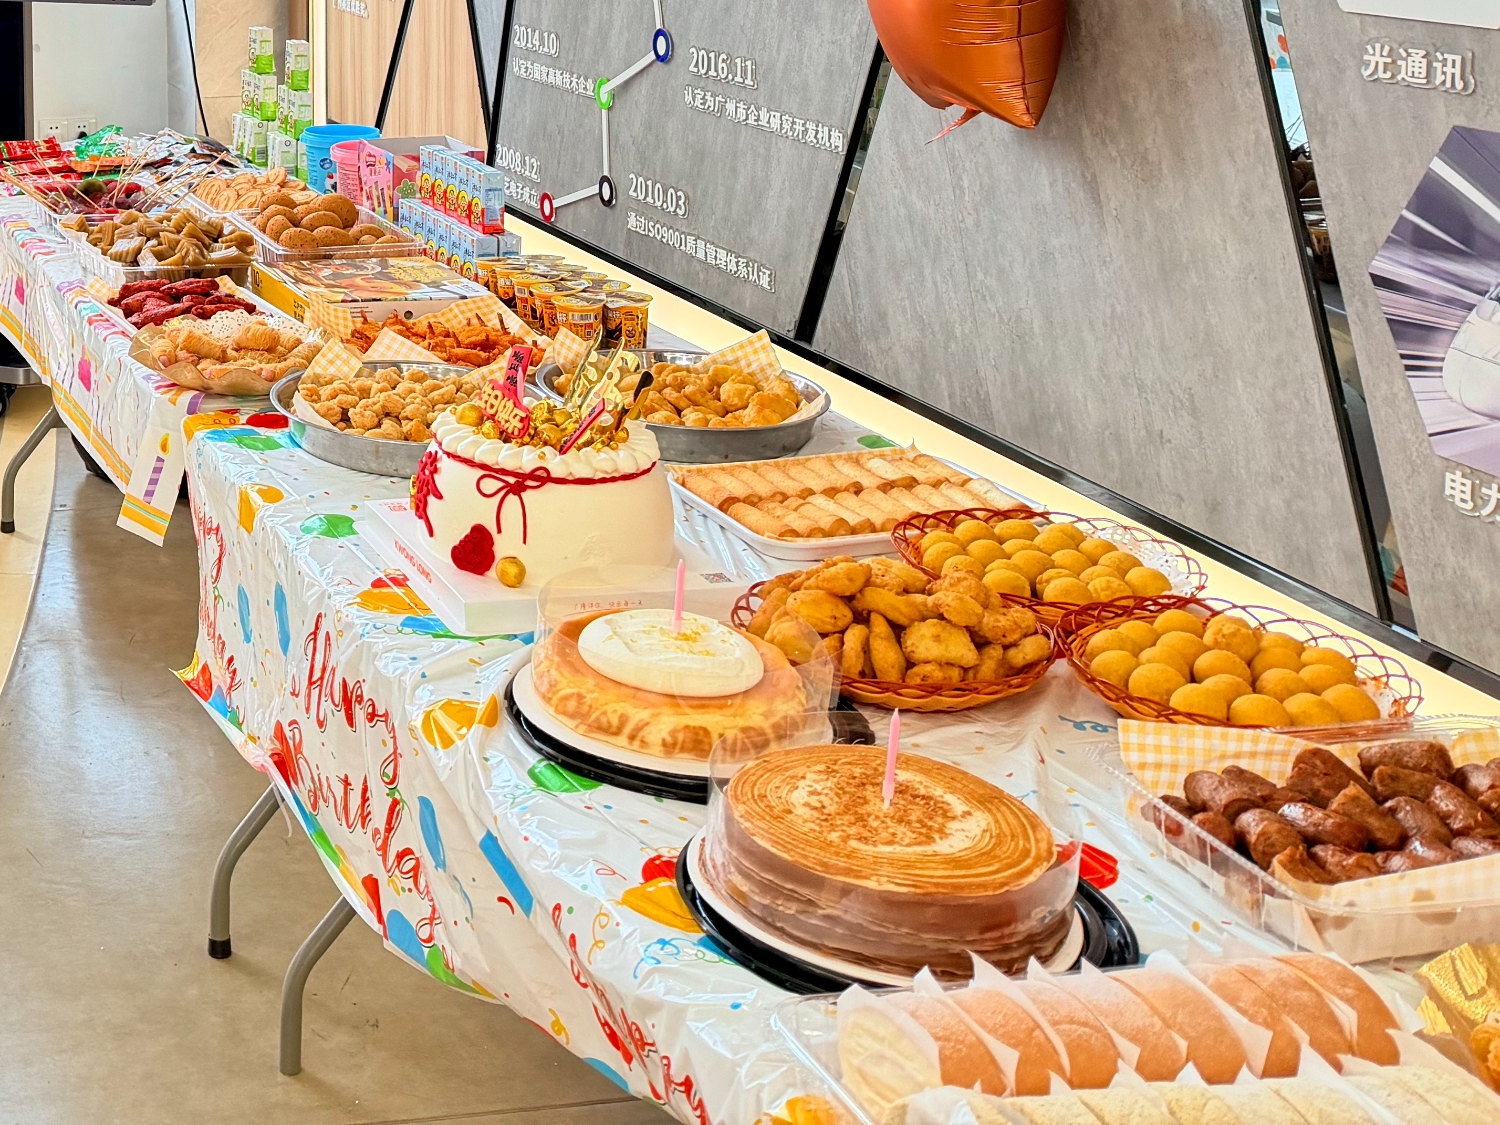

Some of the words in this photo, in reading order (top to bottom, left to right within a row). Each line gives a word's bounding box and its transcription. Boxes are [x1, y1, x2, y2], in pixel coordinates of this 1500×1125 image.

[513, 24, 559, 57] 2014.10
[688, 46, 757, 89] 2016.11
[1362, 42, 1465, 91] 光通讯
[684, 84, 846, 154] 认定为广州市企业研究开发机构
[629, 174, 688, 218] 2010.03
